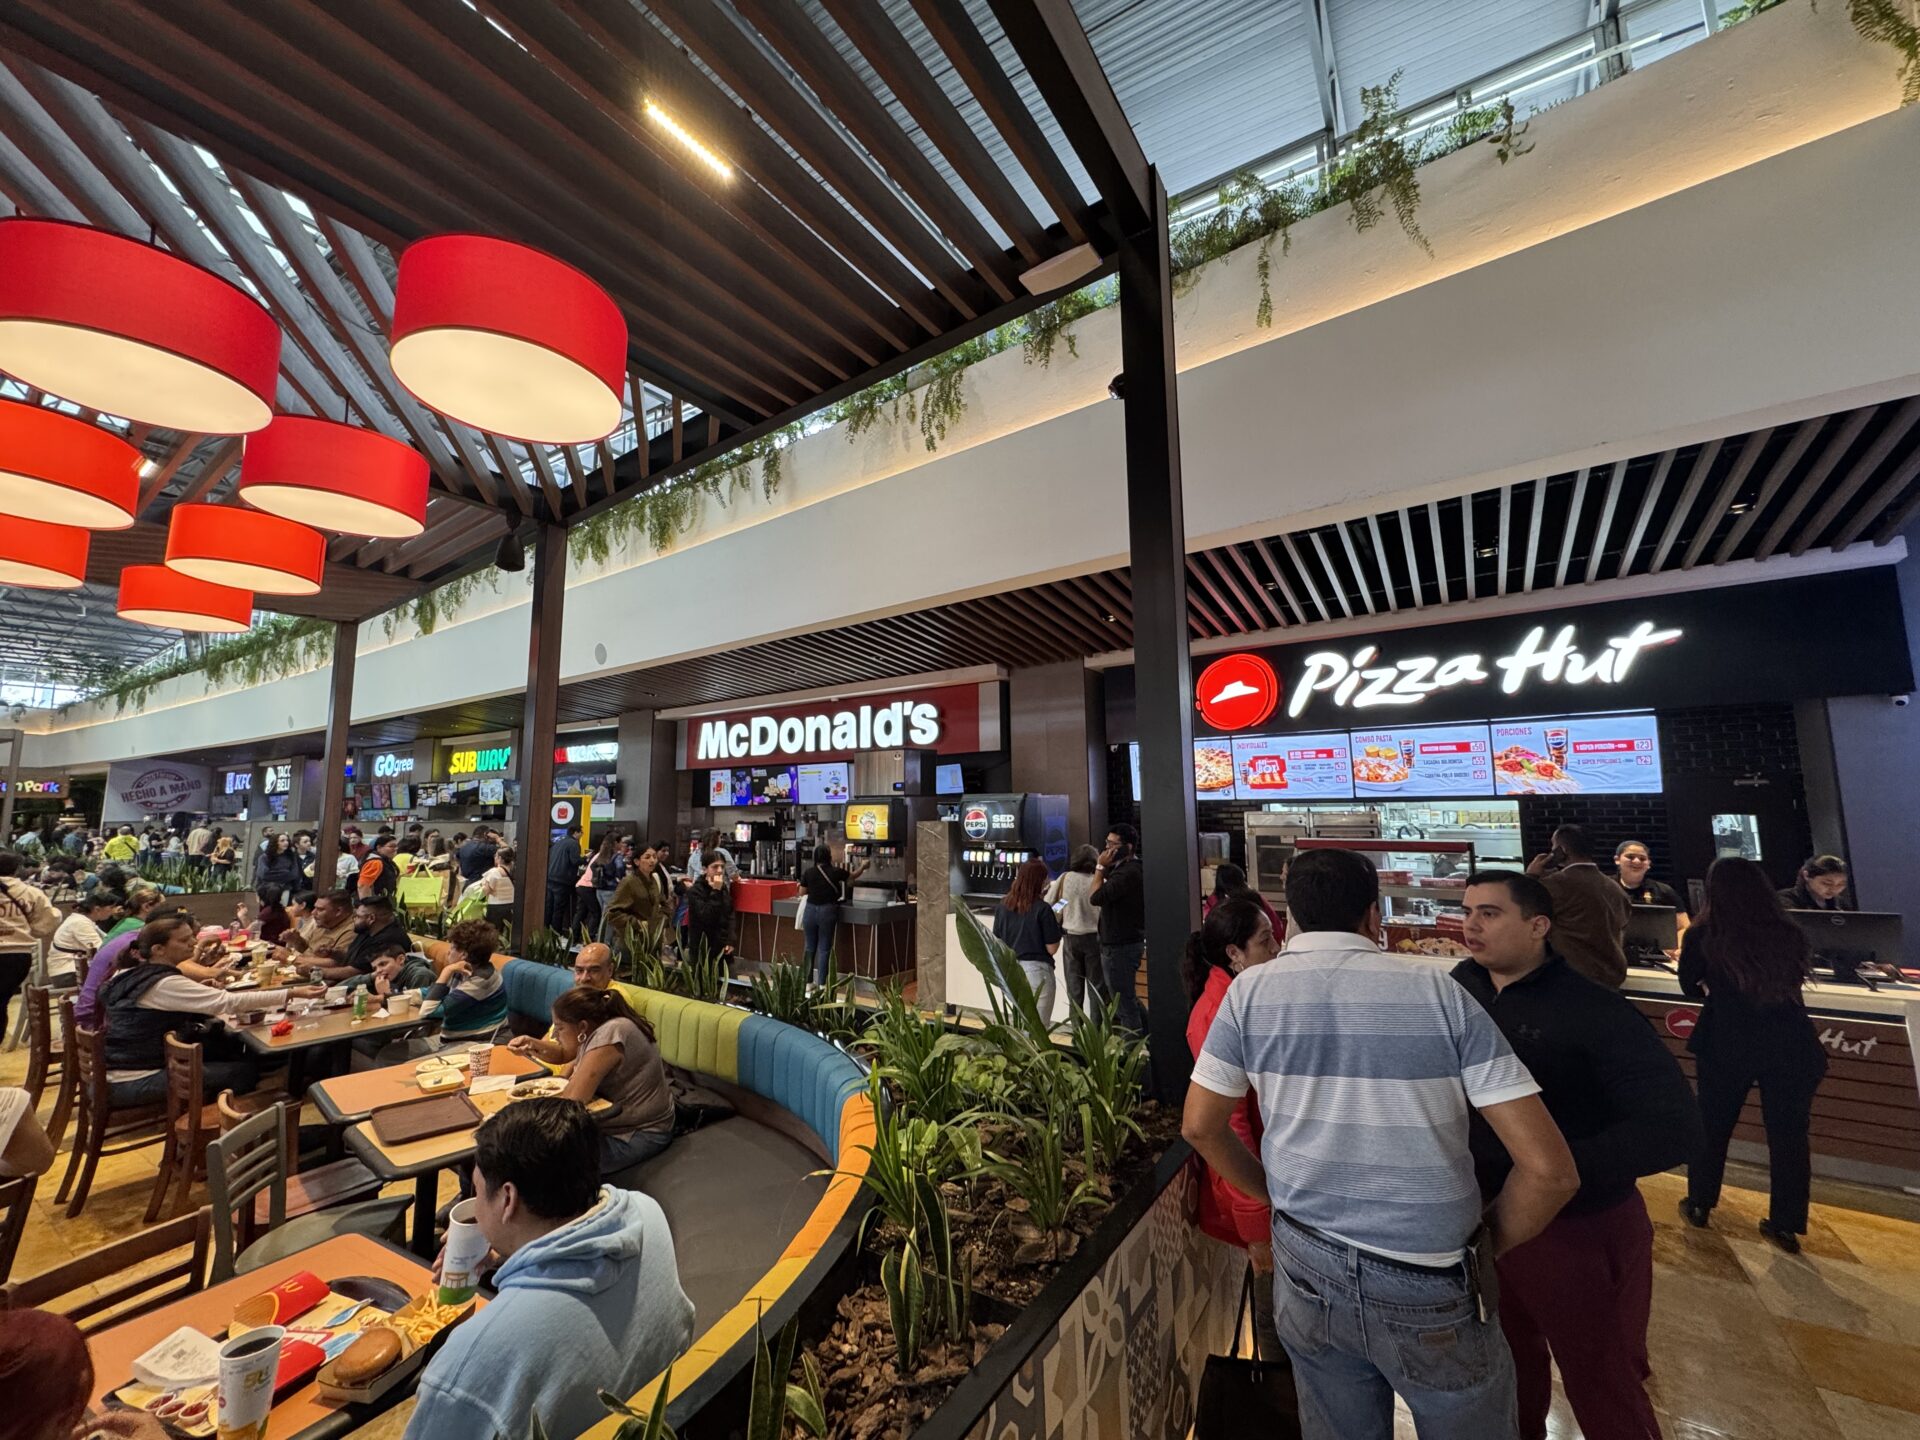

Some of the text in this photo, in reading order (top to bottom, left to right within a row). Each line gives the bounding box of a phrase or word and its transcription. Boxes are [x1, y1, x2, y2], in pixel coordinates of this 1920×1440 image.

[1290, 621, 1683, 718] Pizza Hut
[697, 700, 939, 760] McDonald's
[1355, 734, 1393, 744] COMBO PASTA
[1496, 727, 1532, 737] PORCIONES
[448, 746, 511, 775] SUBWAY
[24, 780, 60, 793] Park
[121, 787, 157, 803] HECHO
[159, 785, 167, 797] A
[168, 778, 202, 795] MANO
[991, 813, 1016, 823] SED
[1818, 1027, 1878, 1057] Hut
